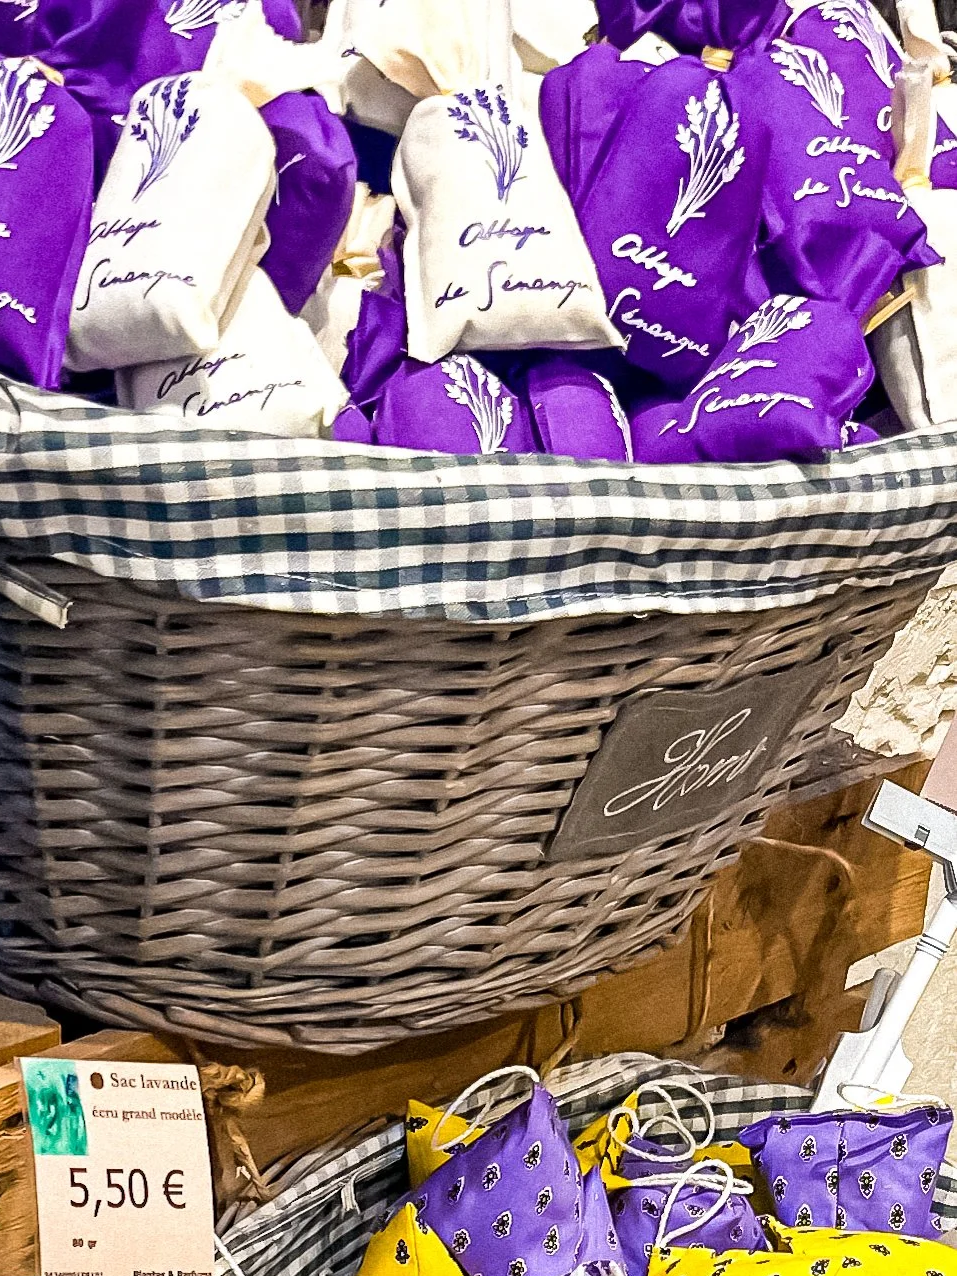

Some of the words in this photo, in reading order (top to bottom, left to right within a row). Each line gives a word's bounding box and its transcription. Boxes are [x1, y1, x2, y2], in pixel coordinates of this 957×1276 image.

[458, 218, 551, 251] Abbaye
[611, 233, 698, 291] Abbaye
[110, 1073, 136, 1089] Sac
[141, 1074, 197, 1091] lavande
[92, 1106, 119, 1119] écru
[122, 1107, 156, 1122] grand
[161, 1108, 203, 1121] modèle
[69, 1167, 150, 1218] 5,50
[162, 1169, 187, 1209] €
